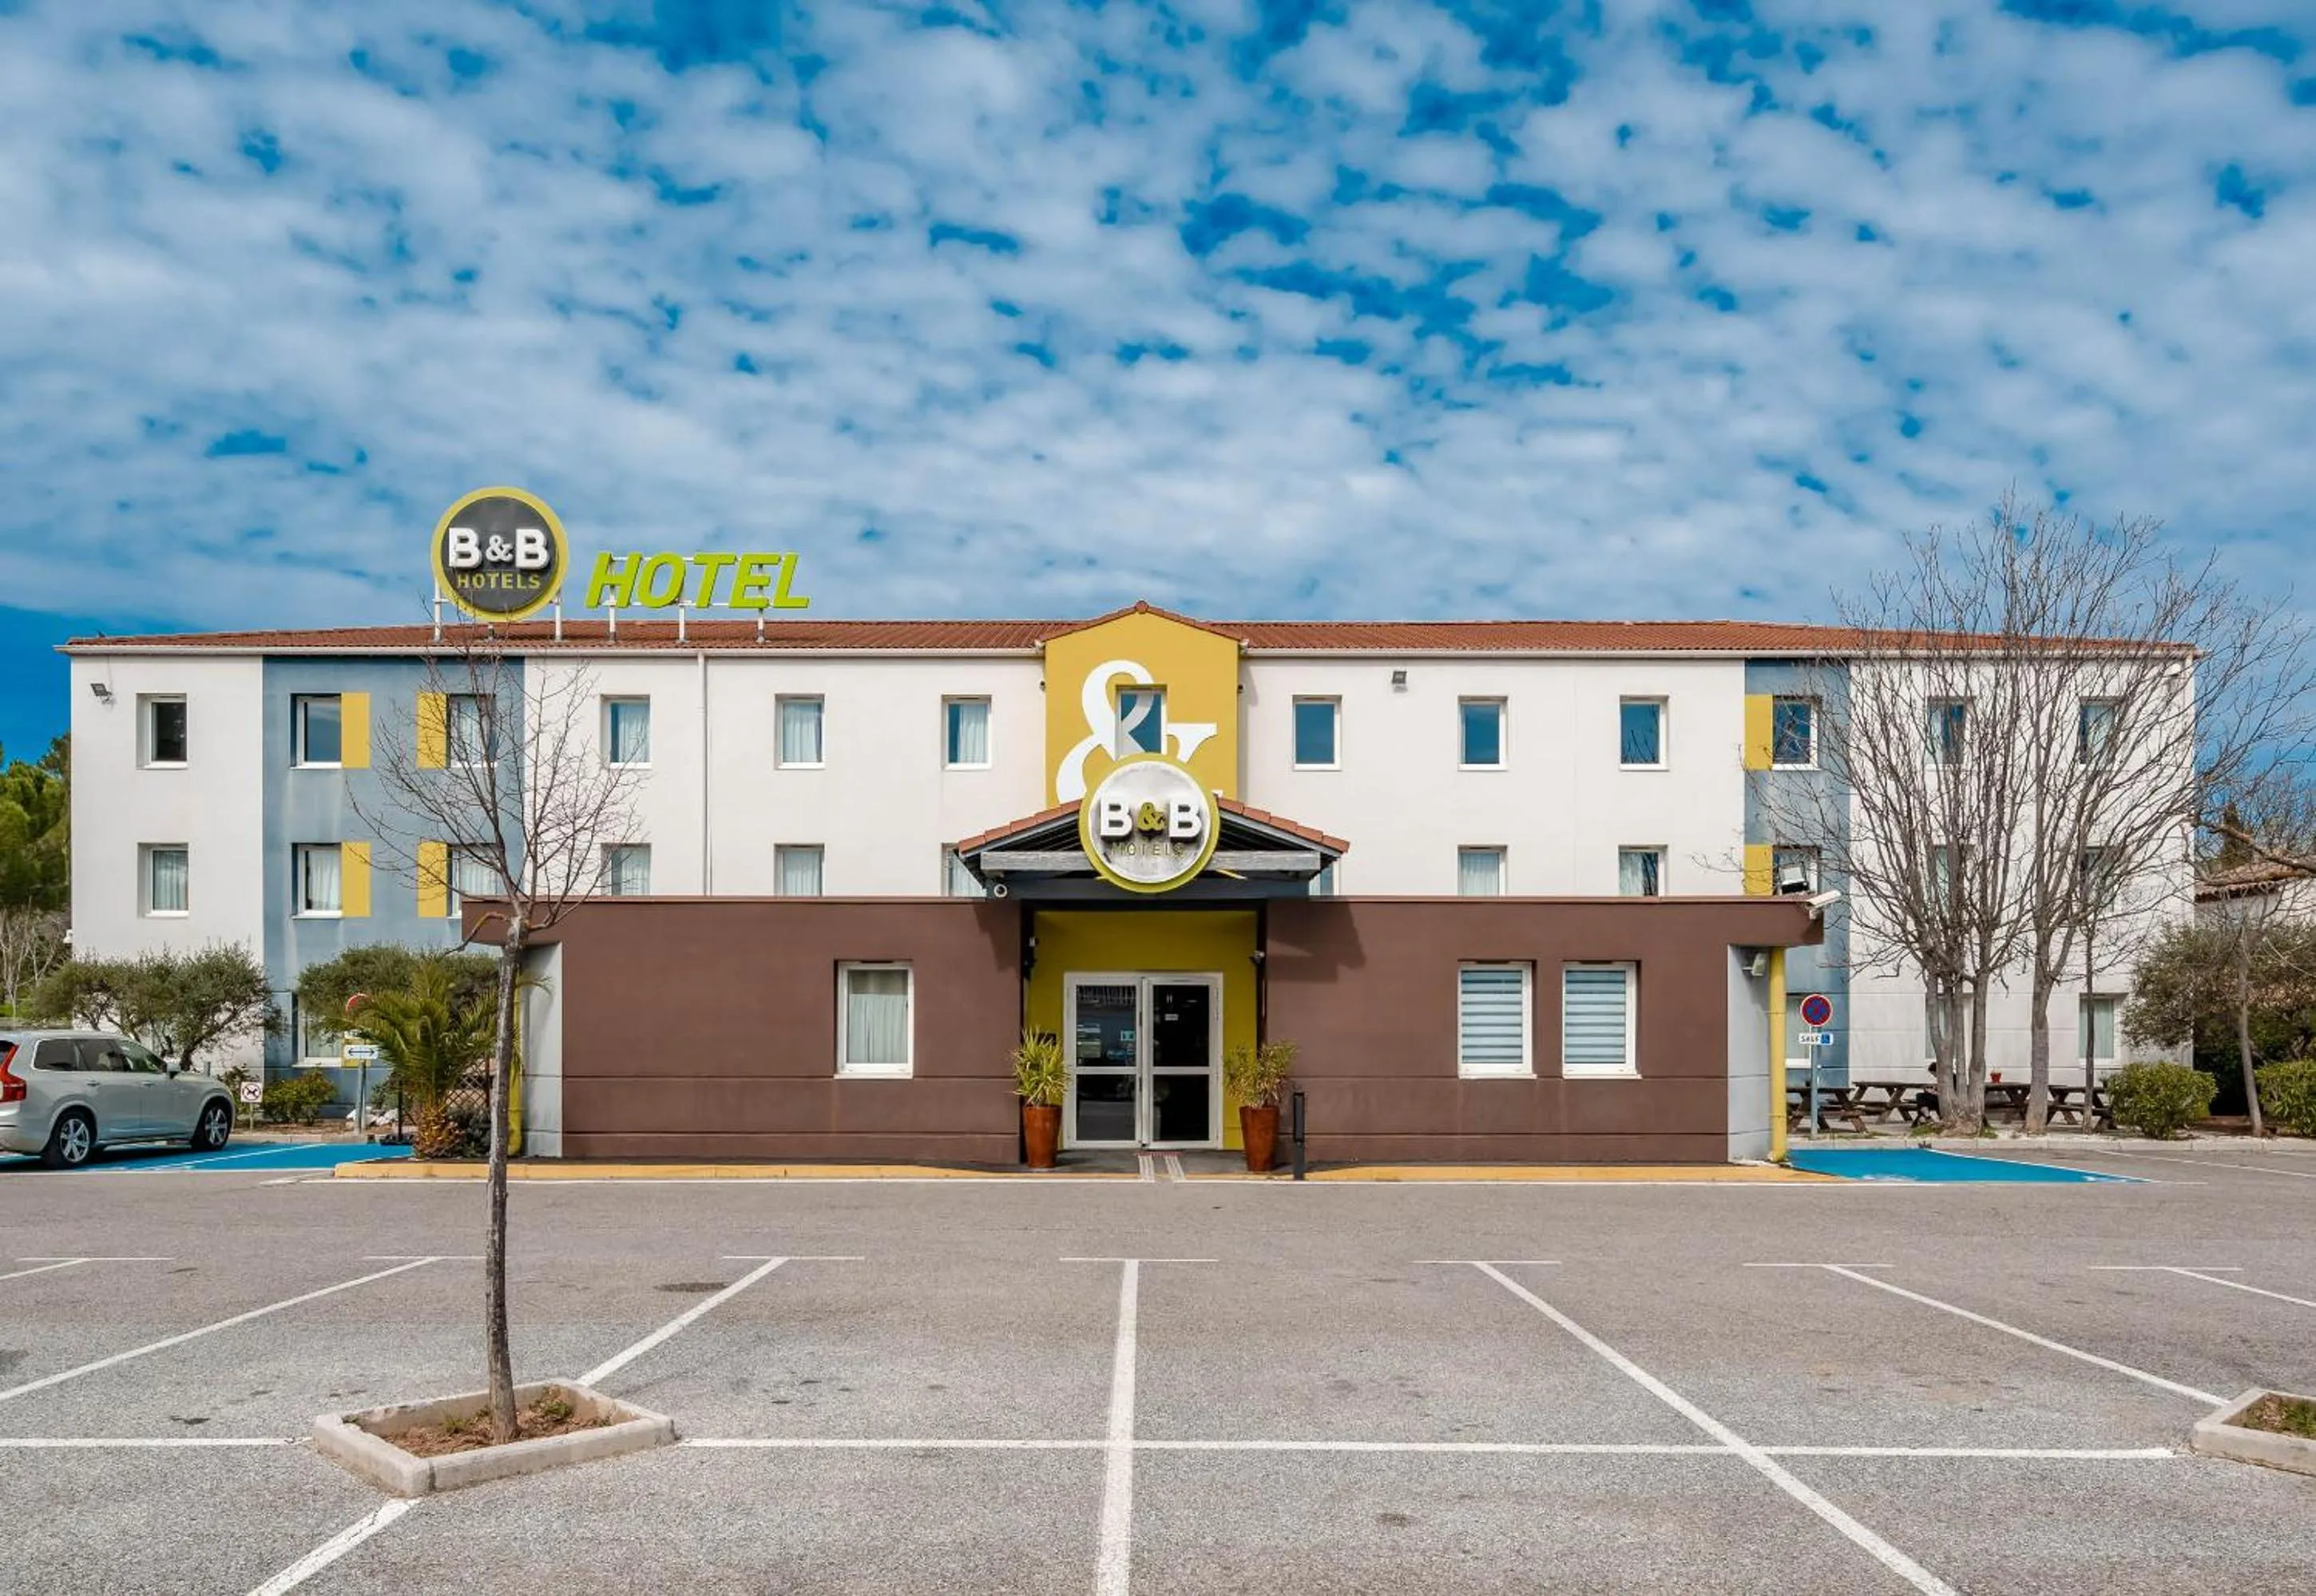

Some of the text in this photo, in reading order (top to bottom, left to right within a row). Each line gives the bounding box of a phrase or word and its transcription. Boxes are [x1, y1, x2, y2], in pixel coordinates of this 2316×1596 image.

[448, 527, 550, 568] B&B
[456, 572, 541, 589] HOTELS
[584, 551, 810, 609] HOTEL
[1100, 798, 1203, 838] B&B
[1111, 842, 1186, 857] HOTELS
